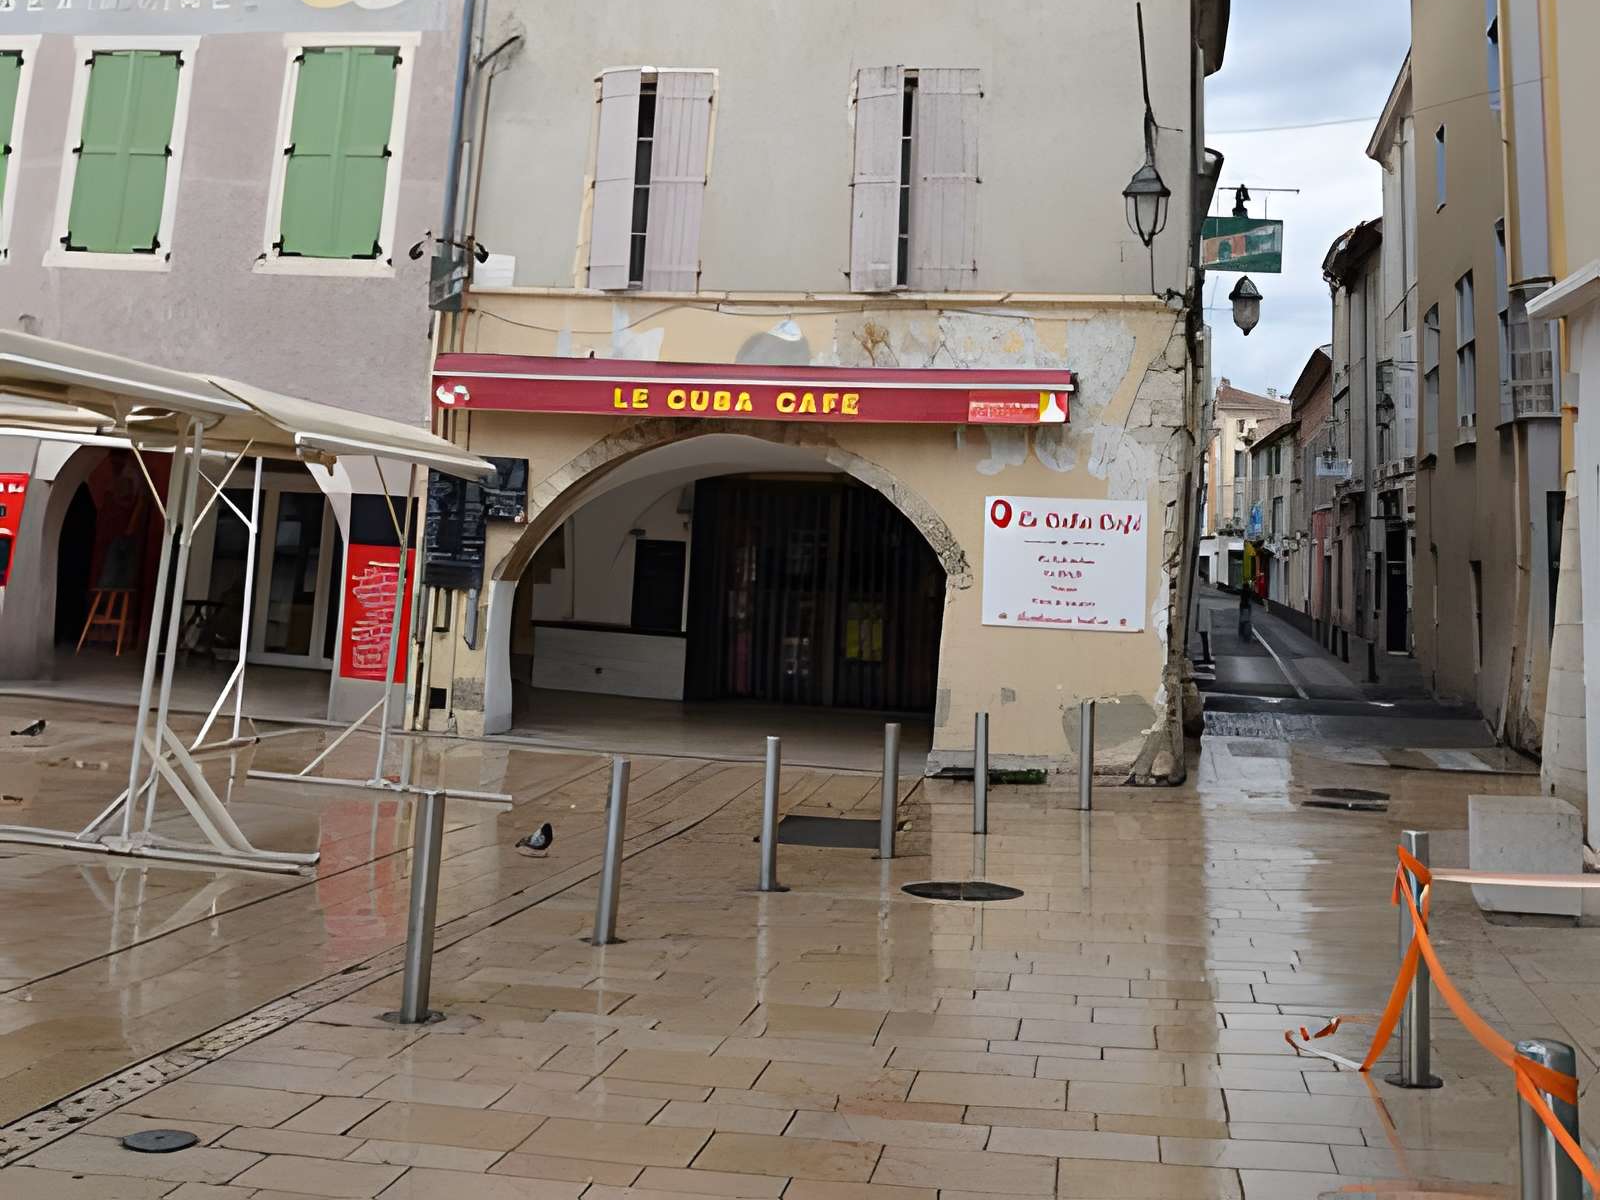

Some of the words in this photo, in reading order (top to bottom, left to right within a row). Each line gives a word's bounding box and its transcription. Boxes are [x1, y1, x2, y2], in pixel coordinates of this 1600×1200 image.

[613, 387, 649, 409] LE
[667, 389, 753, 412] CUBA
[776, 392, 860, 415] CAFE
